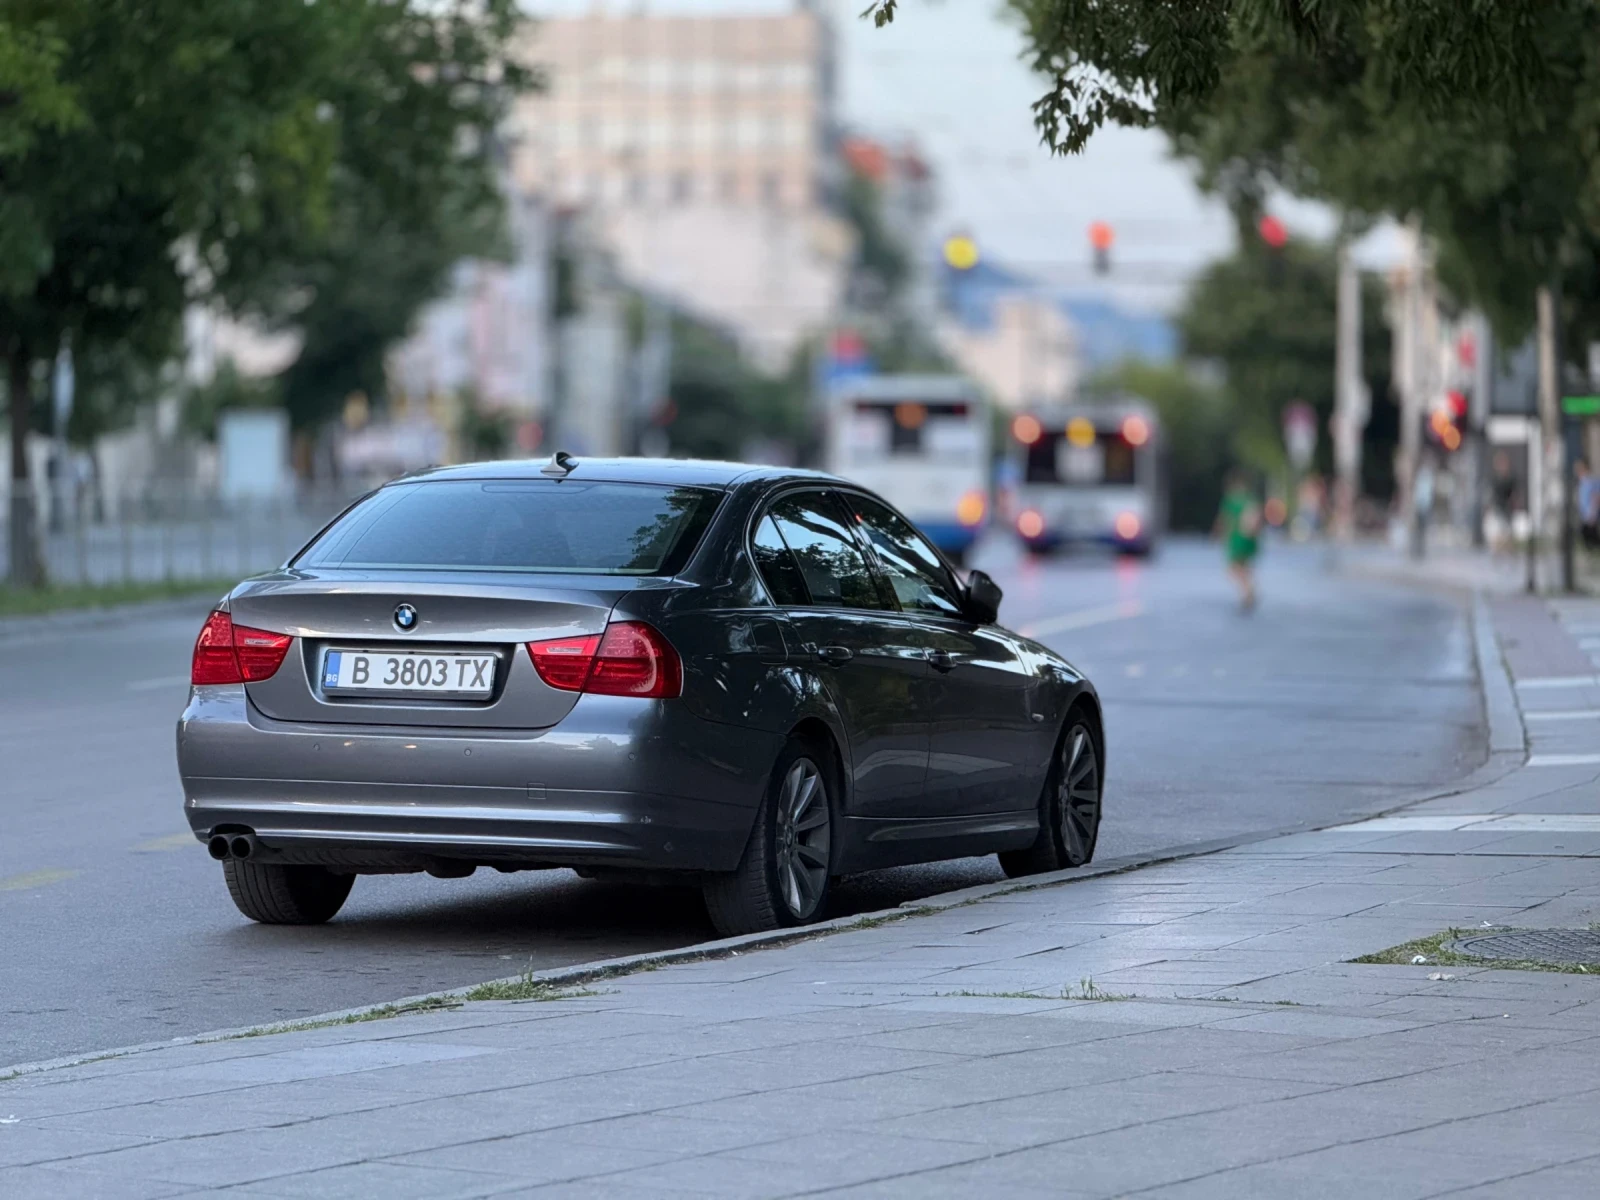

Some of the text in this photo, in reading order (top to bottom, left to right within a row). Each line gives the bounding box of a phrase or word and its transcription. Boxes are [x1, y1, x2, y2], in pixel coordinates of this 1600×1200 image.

[325, 673, 338, 683] BG
[351, 656, 489, 688] B 3803 TX
